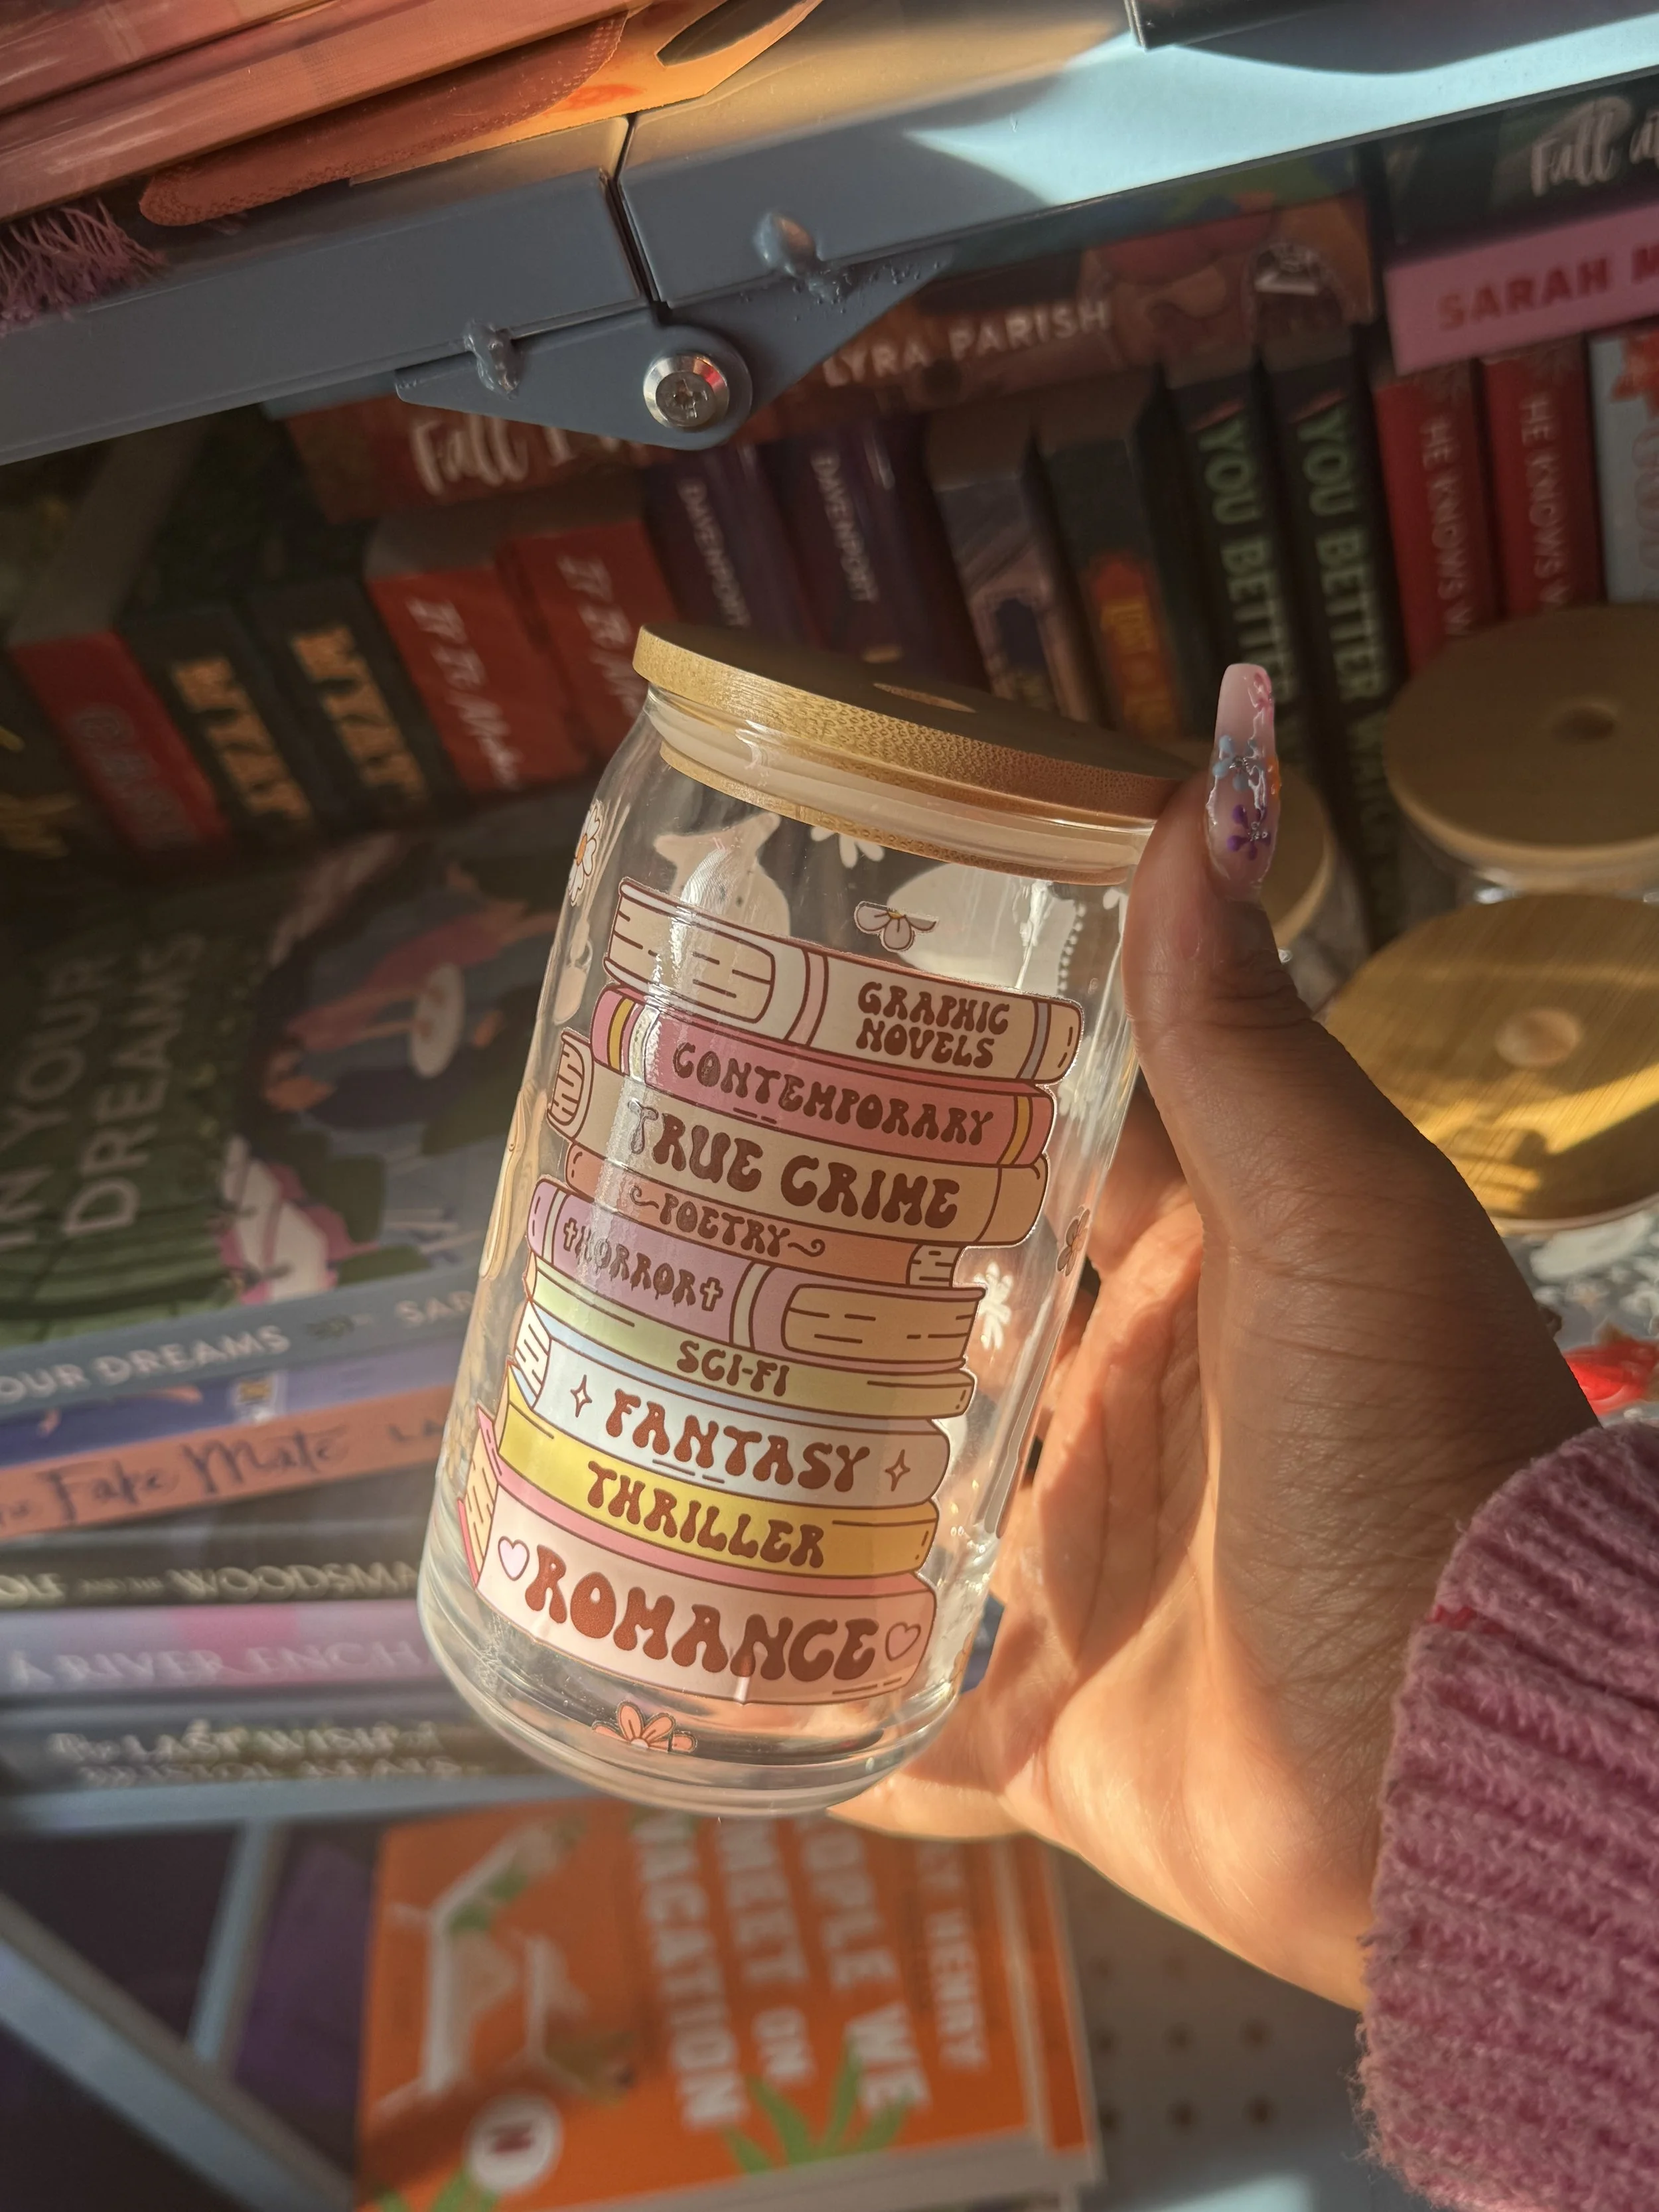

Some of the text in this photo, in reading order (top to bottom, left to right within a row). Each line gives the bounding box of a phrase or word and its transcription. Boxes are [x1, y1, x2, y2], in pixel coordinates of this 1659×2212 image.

[822, 299, 1111, 388] LYRA PARISH
[1433, 256, 1611, 329] SARAH
[1196, 415, 1262, 526] YOU
[1297, 404, 1356, 518] YOU
[1420, 413, 1468, 471] HE
[1520, 392, 1556, 447] HE
[1427, 470, 1468, 600] KNOWS
[1525, 447, 1565, 579] KNOWS
[1317, 528, 1391, 703] BETTER
[0, 953, 118, 1155] YOUR
[855, 1017, 995, 1069] NOVELS
[858, 980, 1011, 1036] GRAPHIC
[59, 932, 206, 1238] DREAMS
[672, 1041, 994, 1146] CONTEMPORARY
[626, 1097, 960, 1230] TRUE CRIME
[575, 1224, 696, 1306] HORROR
[659, 1193, 790, 1258] POETRY
[0, 1362, 91, 1404] OUR
[90, 1324, 291, 1387] DREAMS
[676, 1339, 789, 1398] SCI-FI
[36, 1457, 179, 1522] Fake
[181, 1424, 349, 1495] Mate
[605, 1388, 871, 1493] FANTASY
[588, 1460, 824, 1569] THRILLER
[524, 1544, 879, 1681] ROMANCE
[632, 1810, 750, 2124] VACATION
[714, 1815, 818, 2084] MEET ON
[793, 1813, 934, 2117] OPLE WE
[925, 1909, 991, 2069] HENRY
